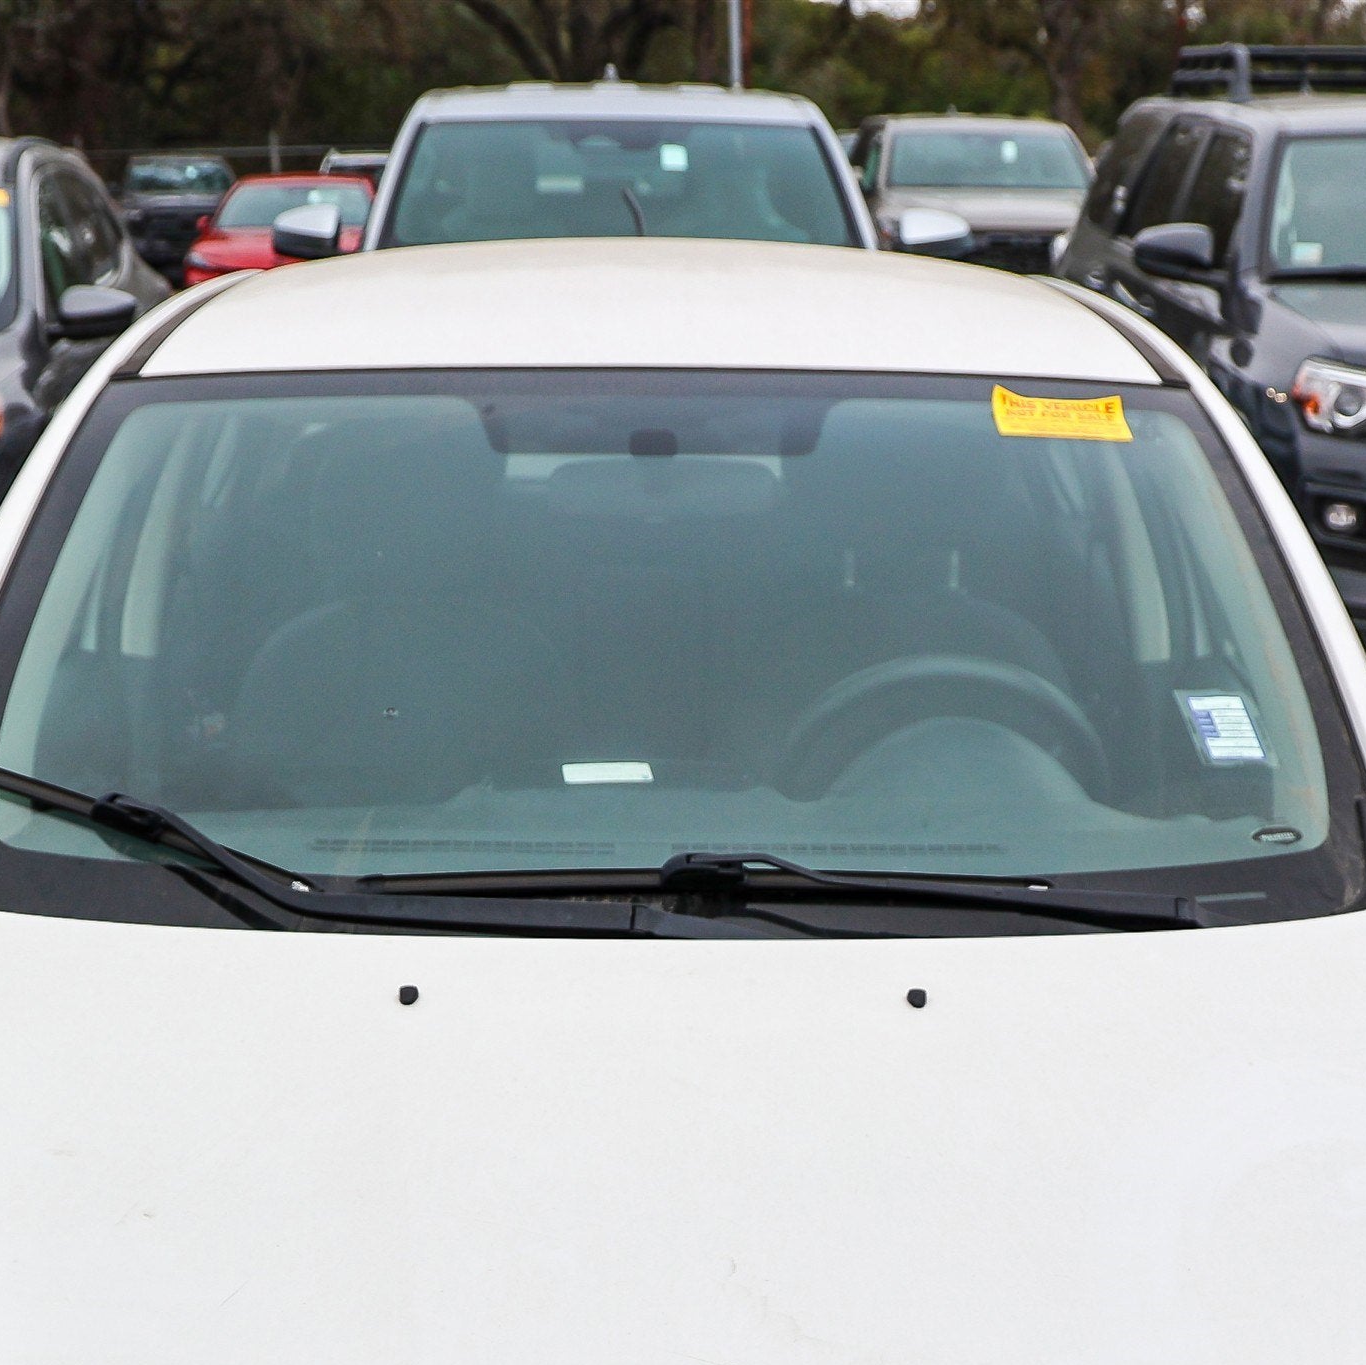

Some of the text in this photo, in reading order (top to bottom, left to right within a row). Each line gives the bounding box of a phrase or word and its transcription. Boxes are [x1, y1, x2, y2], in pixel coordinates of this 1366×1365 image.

[1000, 392, 1116, 414] THIS VEHICLE
[1006, 408, 1114, 421] NOT FOR SALE
